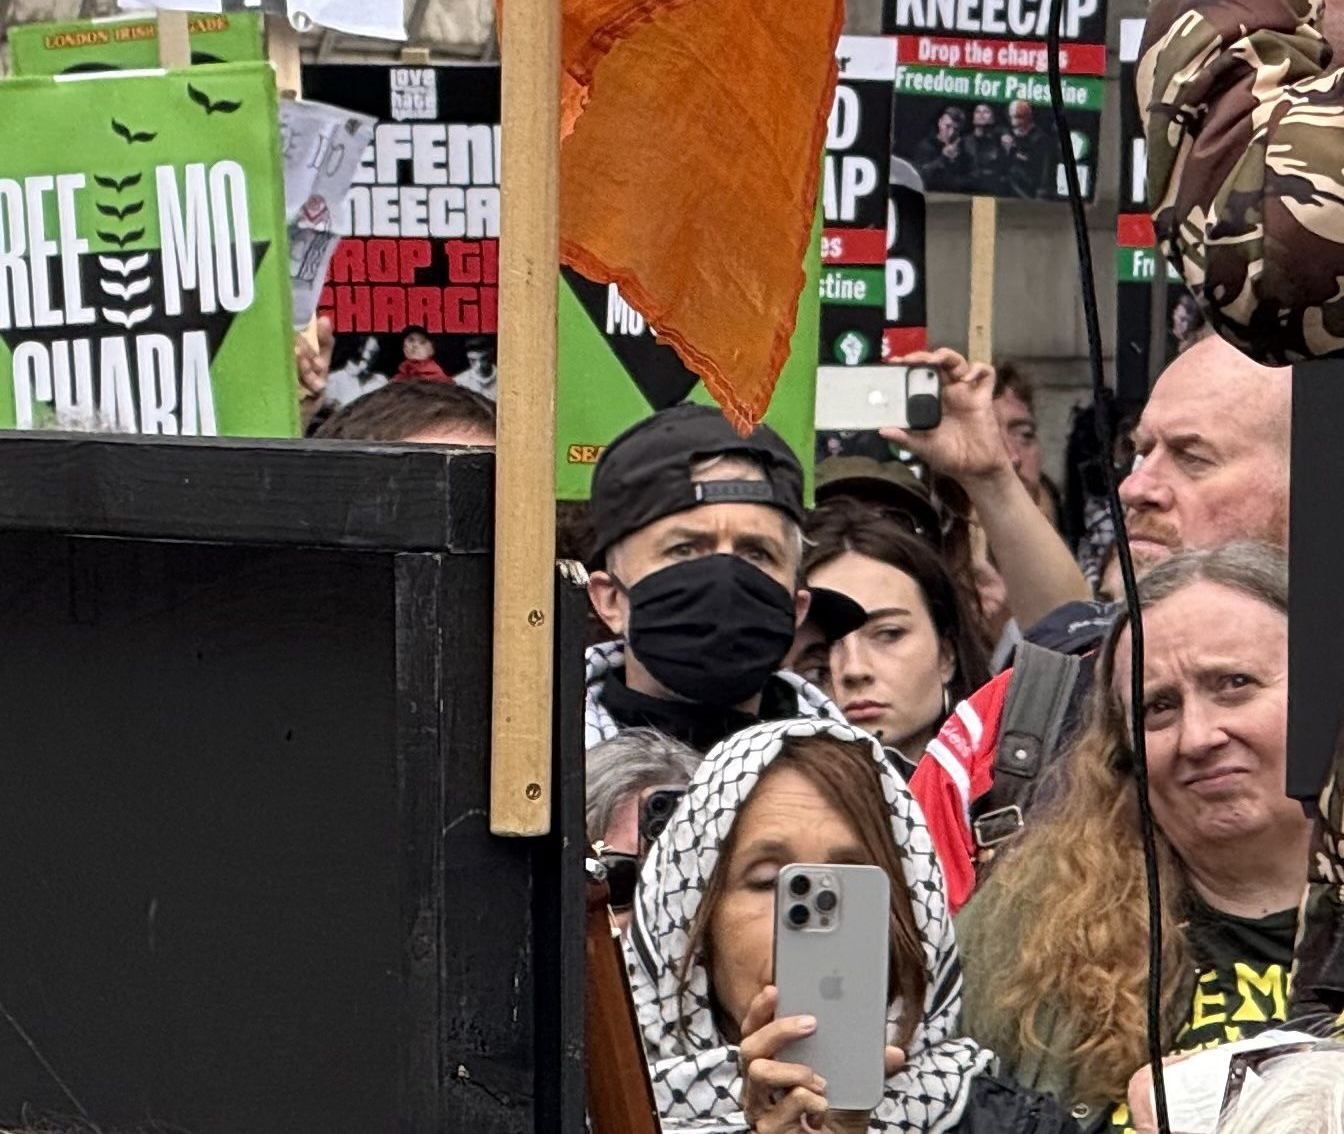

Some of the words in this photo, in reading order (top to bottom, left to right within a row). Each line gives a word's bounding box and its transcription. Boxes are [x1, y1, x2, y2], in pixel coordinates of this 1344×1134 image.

[45, 30, 109, 49] LONDON
[114, 24, 157, 41] IRISH
[918, 37, 961, 65] Drop
[965, 41, 994, 63] the
[997, 46, 1070, 73] chargs
[895, 65, 970, 95] Freedom
[974, 72, 1000, 96] for
[1004, 75, 1089, 103] Palesine
[0, 173, 97, 329] REE
[155, 159, 255, 316] MO
